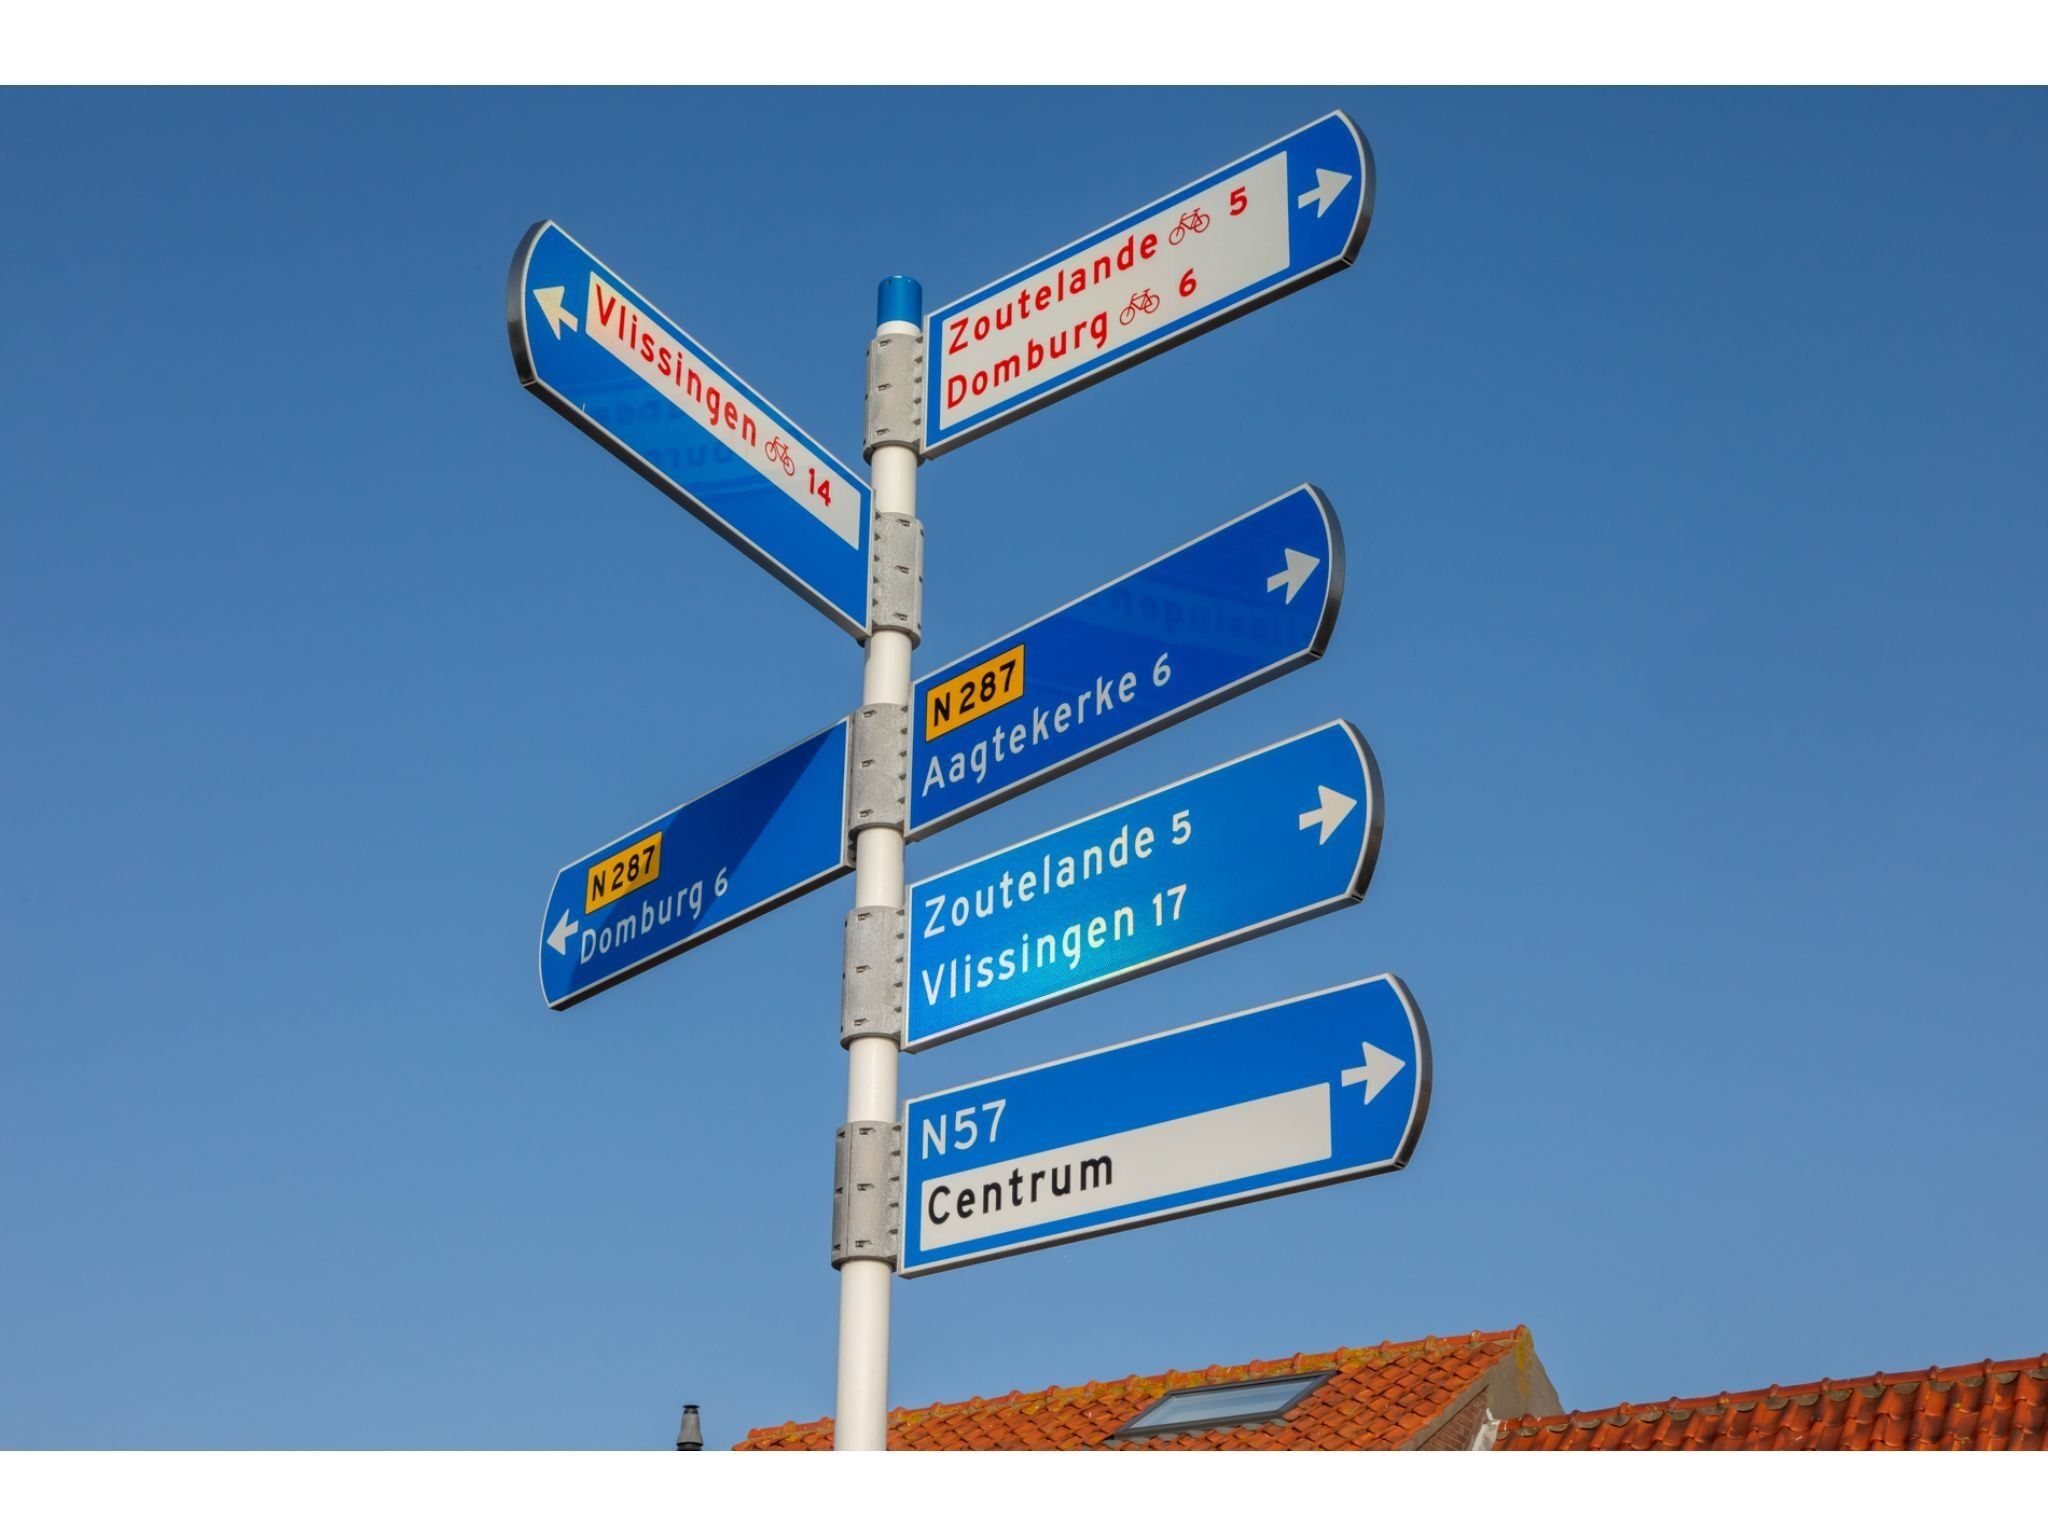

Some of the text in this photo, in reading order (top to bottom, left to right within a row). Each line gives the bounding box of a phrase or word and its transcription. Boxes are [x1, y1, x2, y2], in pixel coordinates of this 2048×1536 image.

[948, 186, 1249, 355] Zoutelande 5
[596, 283, 832, 507] Vlissingen 14
[947, 268, 1197, 408] Domburg 6
[922, 652, 1171, 798] Aagtekerke 6
[580, 866, 728, 964] Domburg 6
[924, 809, 1191, 937] Zoutelande 5
[922, 884, 1187, 1005] Vlissingen 17
[922, 1099, 1006, 1160] N57
[929, 1155, 1113, 1225] Centrum
